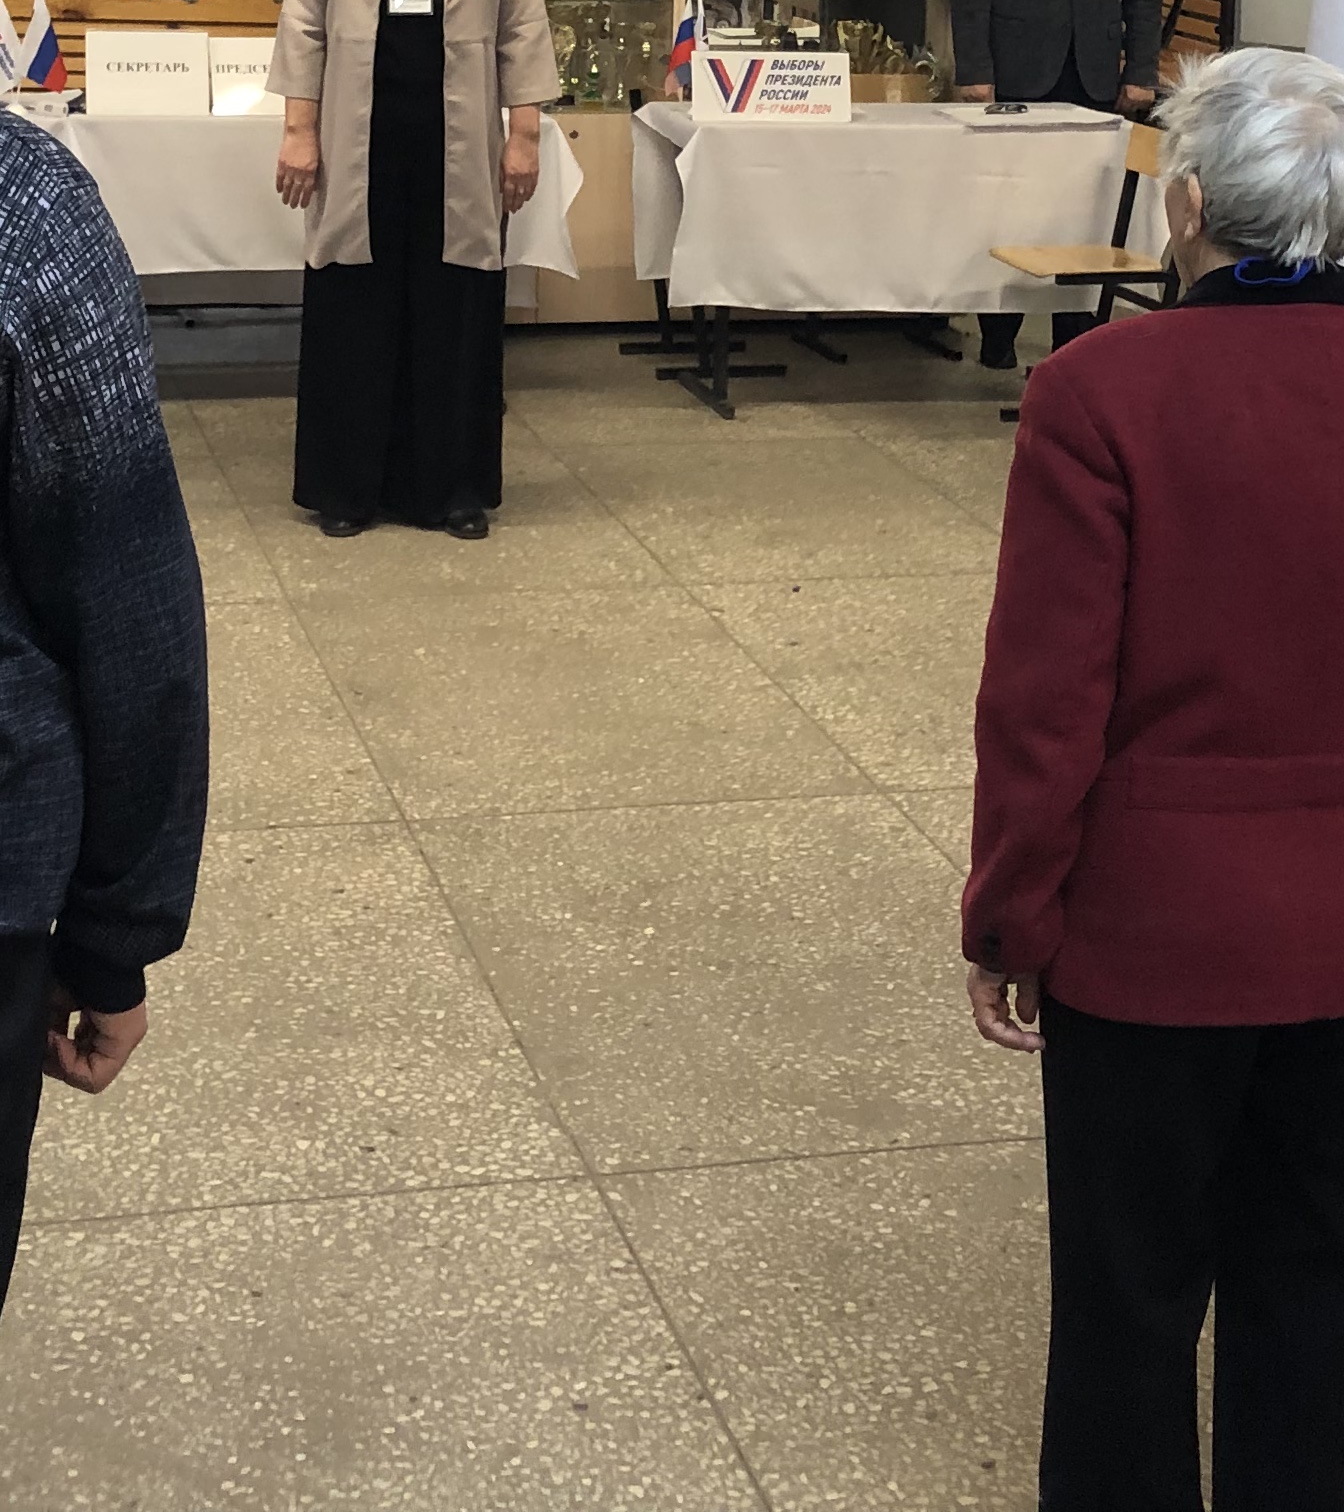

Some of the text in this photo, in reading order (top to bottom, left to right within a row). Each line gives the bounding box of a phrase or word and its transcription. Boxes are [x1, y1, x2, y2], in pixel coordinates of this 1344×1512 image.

[106, 61, 190, 74] СЕКРЕТАРЬ
[216, 63, 270, 75] ПРЕДСЕ
[770, 60, 825, 71] ВЫБОРЫ
[765, 74, 841, 87] ПРЕЗИДЕНТА
[759, 89, 809, 100] РОССИИ
